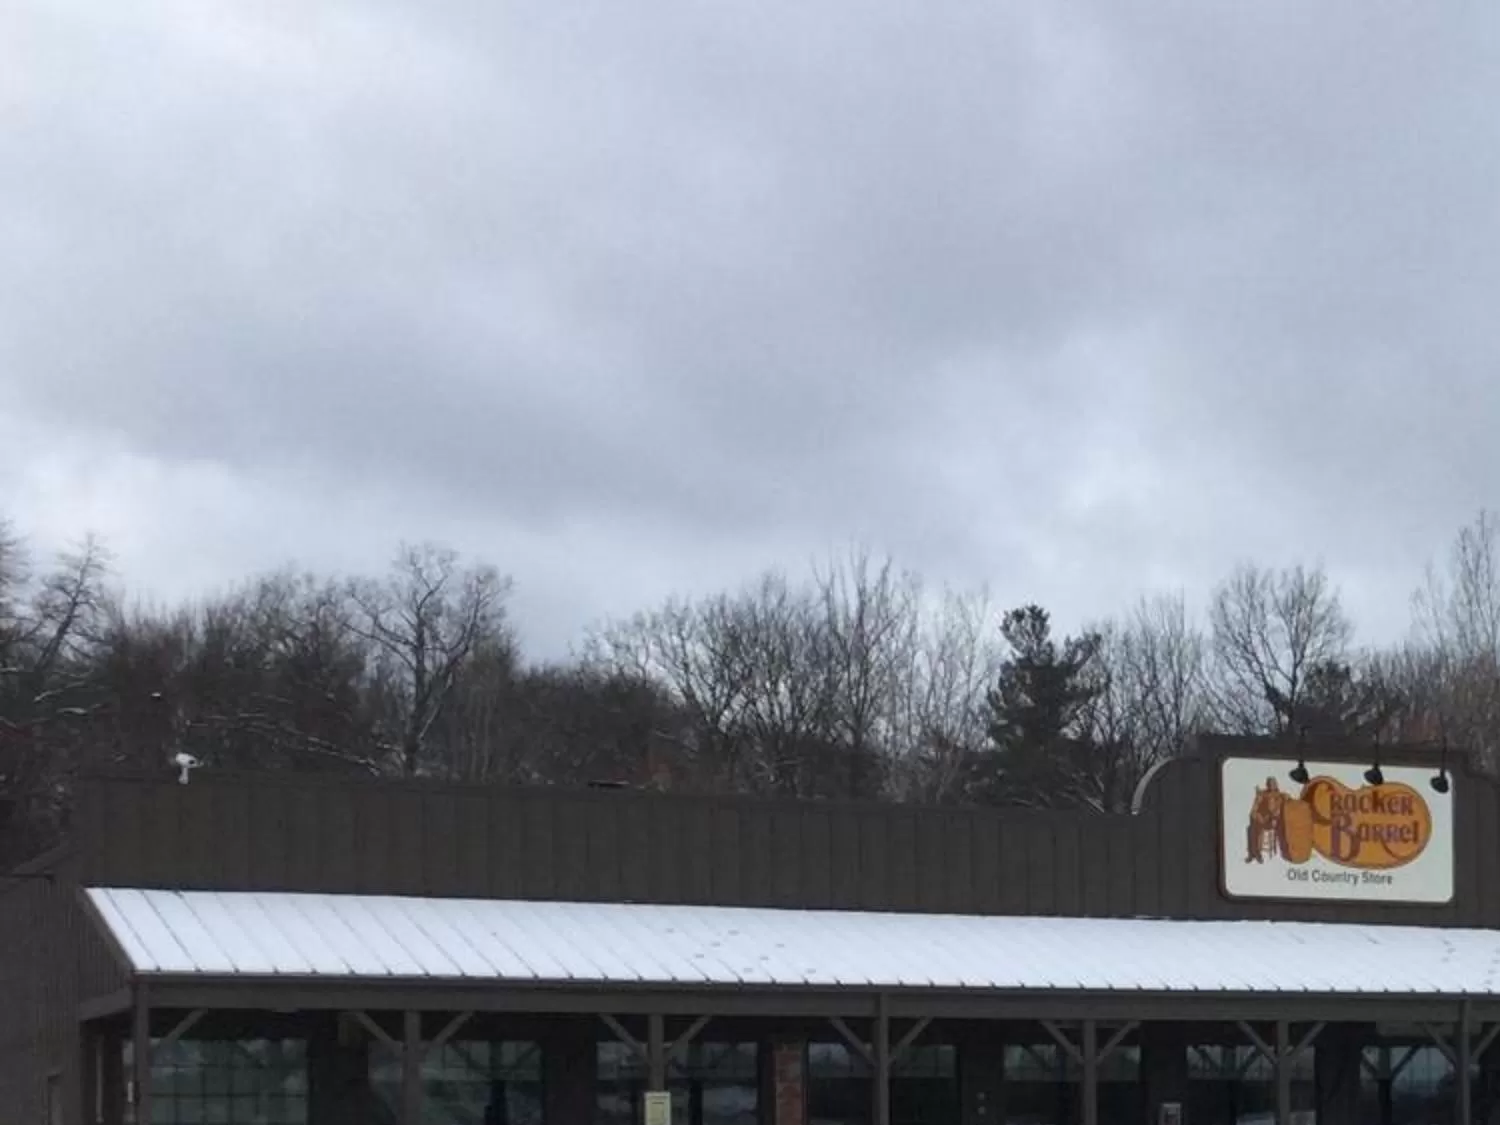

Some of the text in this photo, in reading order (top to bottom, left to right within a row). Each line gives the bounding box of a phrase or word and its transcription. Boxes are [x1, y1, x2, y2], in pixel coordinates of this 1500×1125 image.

[1309, 779, 1414, 826] Cracker
[1330, 813, 1419, 862] Barrel
[1287, 868, 1393, 886] Old Country Store
